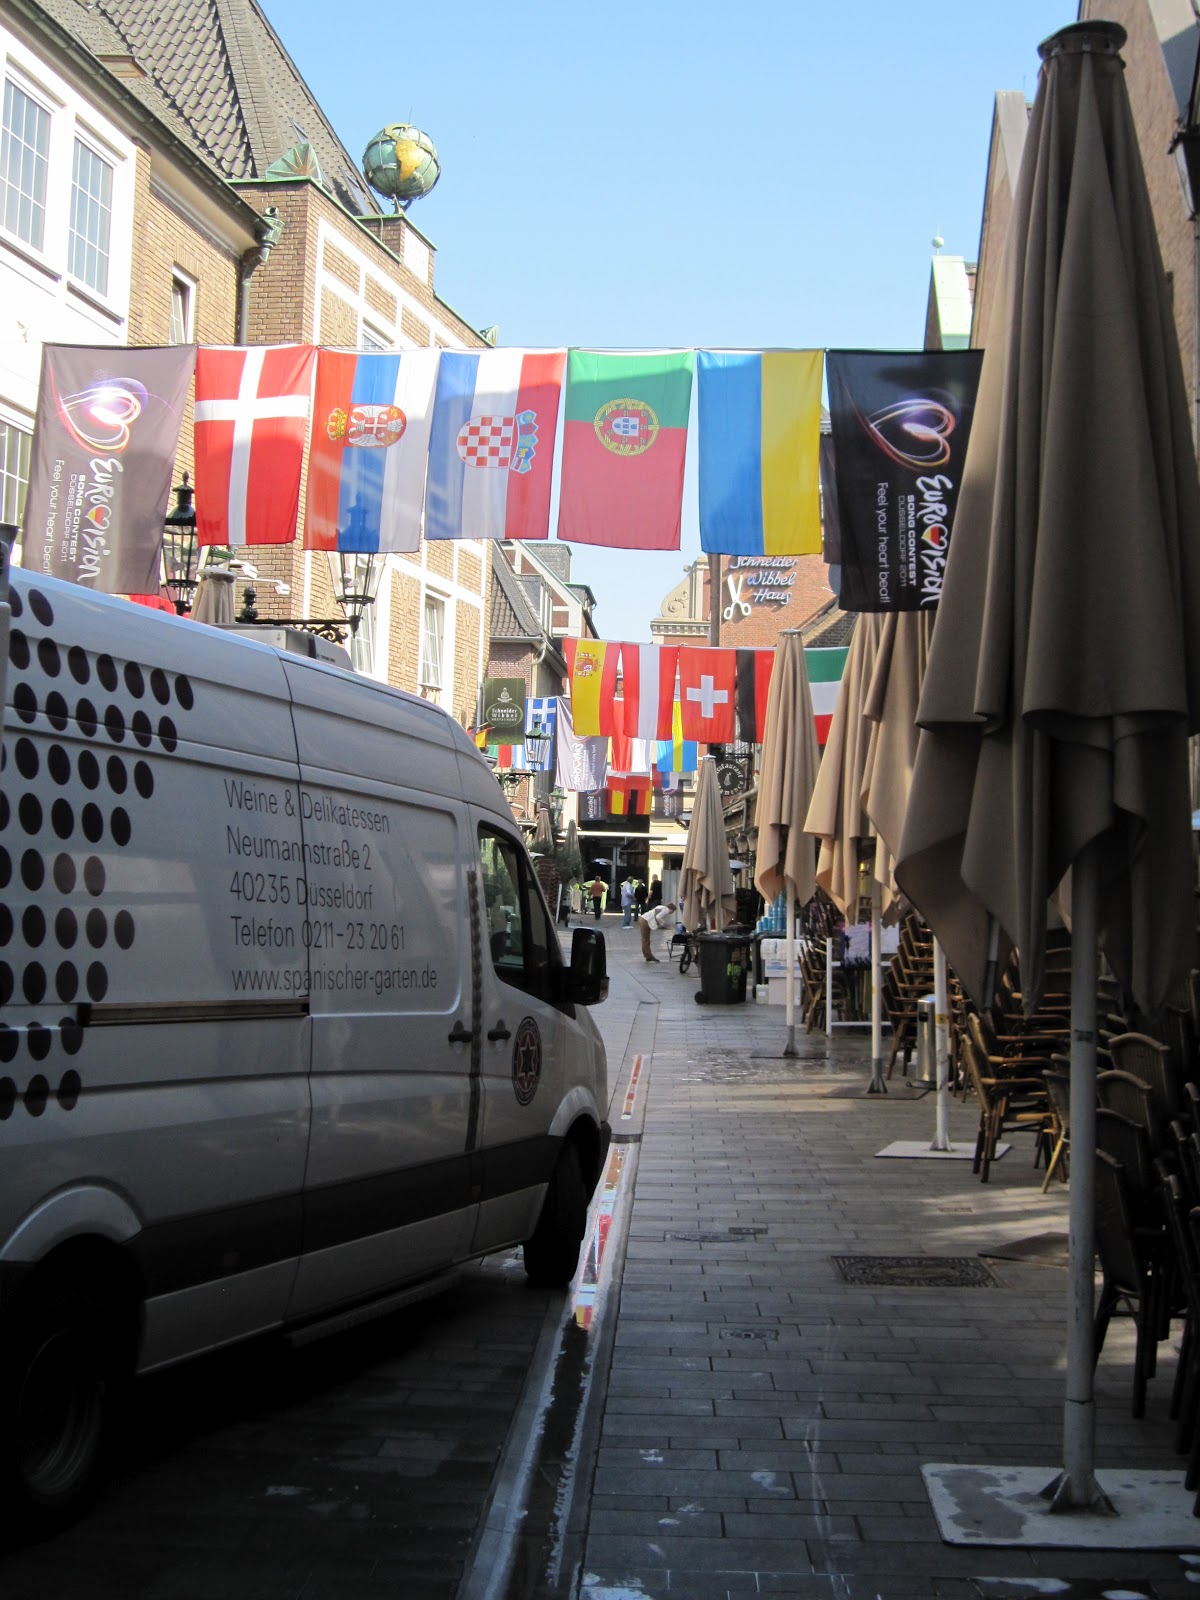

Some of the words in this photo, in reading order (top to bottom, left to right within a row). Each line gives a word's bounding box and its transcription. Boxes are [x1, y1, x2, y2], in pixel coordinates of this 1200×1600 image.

[52, 459, 65, 482] Feel
[50, 484, 59, 508] your
[75, 474, 86, 506] SONG
[877, 482, 889, 506] Feel
[45, 512, 58, 542] heart
[876, 508, 887, 533] your
[907, 494, 916, 528] SONG
[69, 508, 82, 562] CONTEST
[60, 540, 68, 563] 2011
[878, 536, 890, 568] heart
[908, 530, 917, 586] CONTEST
[746, 570, 797, 587] Wibbel
[878, 571, 891, 603] beat!
[899, 566, 907, 587] 2011
[752, 588, 793, 605] Haus
[224, 778, 278, 815] Weine
[284, 788, 297, 818] &
[300, 791, 390, 834] Delikatessen
[226, 824, 360, 870] Neumannstraße
[363, 844, 372, 870] 2
[230, 871, 290, 904] 40235
[296, 878, 374, 910] Düsseldorf
[231, 916, 295, 948] Telefon
[370, 923, 388, 950] 20
[391, 924, 406, 950] 61
[232, 962, 438, 996] www.spanischer-garten.de
